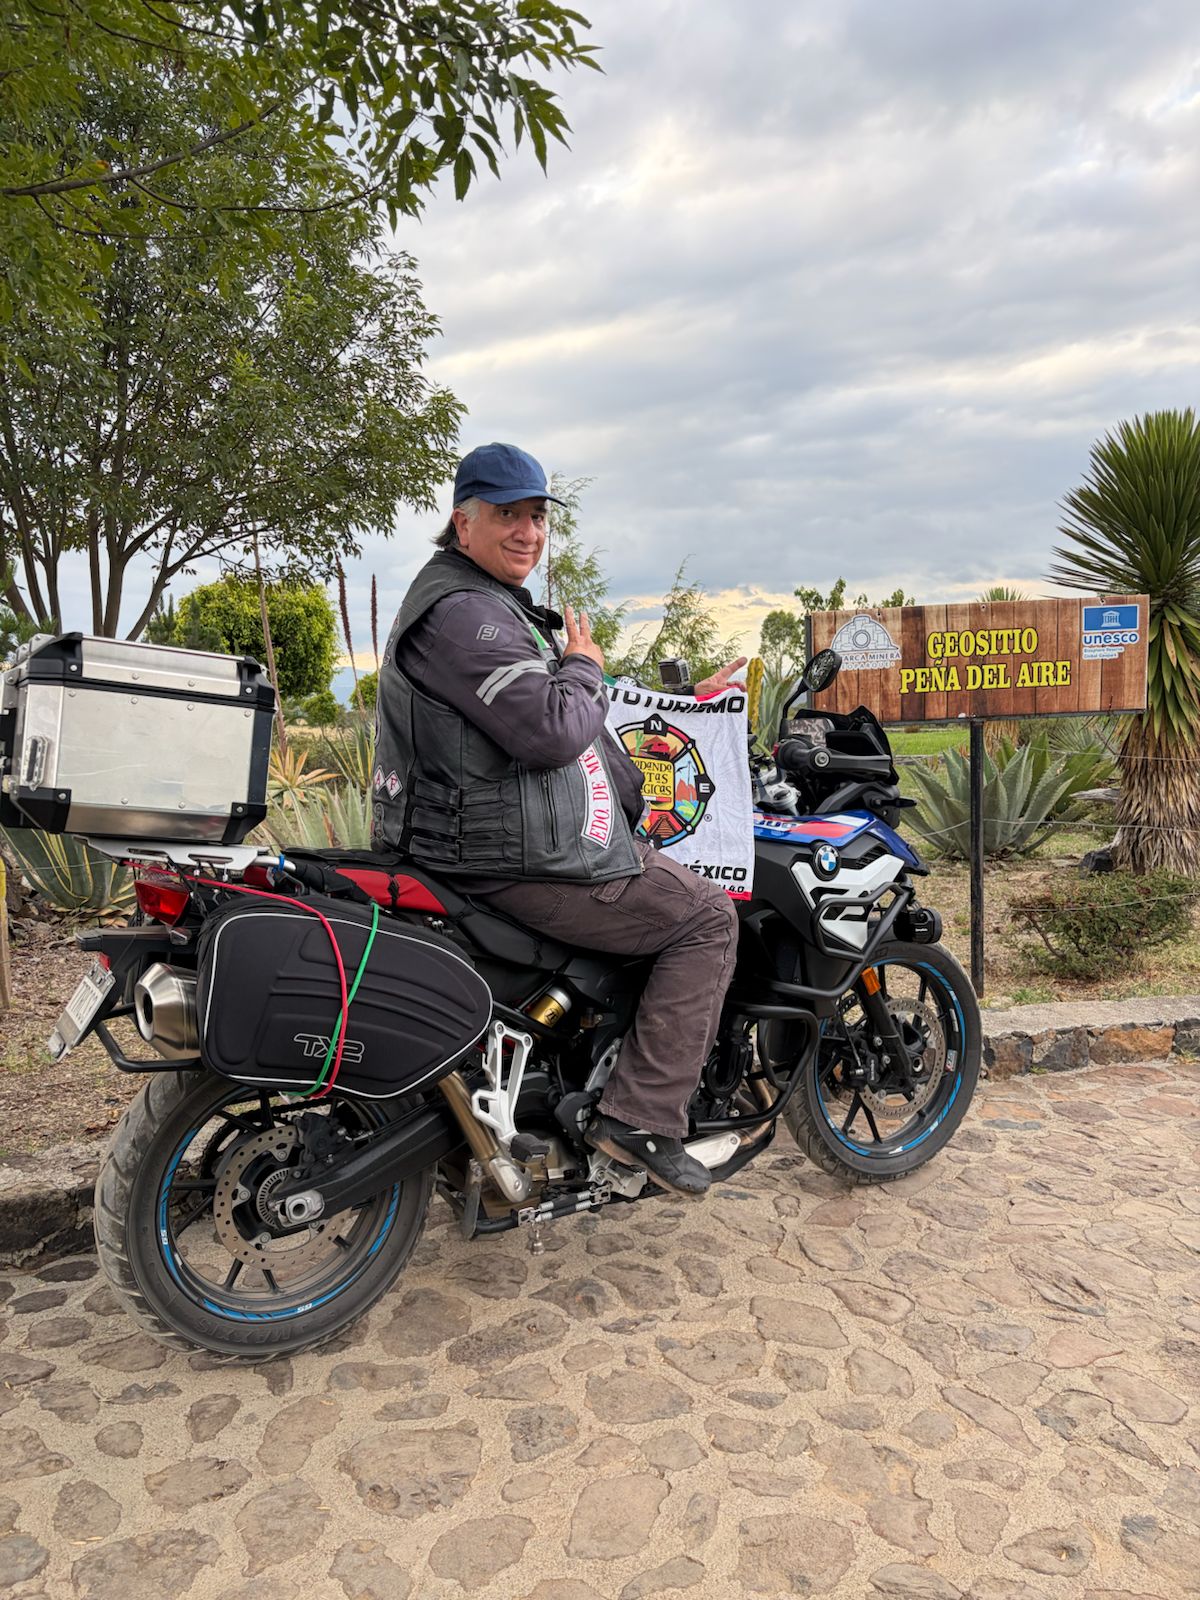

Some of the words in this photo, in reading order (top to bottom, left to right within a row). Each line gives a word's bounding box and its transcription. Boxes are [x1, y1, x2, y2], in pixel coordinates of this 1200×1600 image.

[927, 627, 1039, 659] GEOSITIO
[1084, 633, 1138, 645] unesco
[841, 654, 866, 662] ARCA
[899, 659, 962, 694] PEÑA
[965, 663, 1012, 691] DEL
[1015, 660, 1072, 688] AIRE
[650, 720, 663, 731] N
[591, 780, 610, 801] DE
[699, 783, 711, 793] E
[683, 860, 747, 881] ÉXICO
[293, 1032, 366, 1064] TX2
